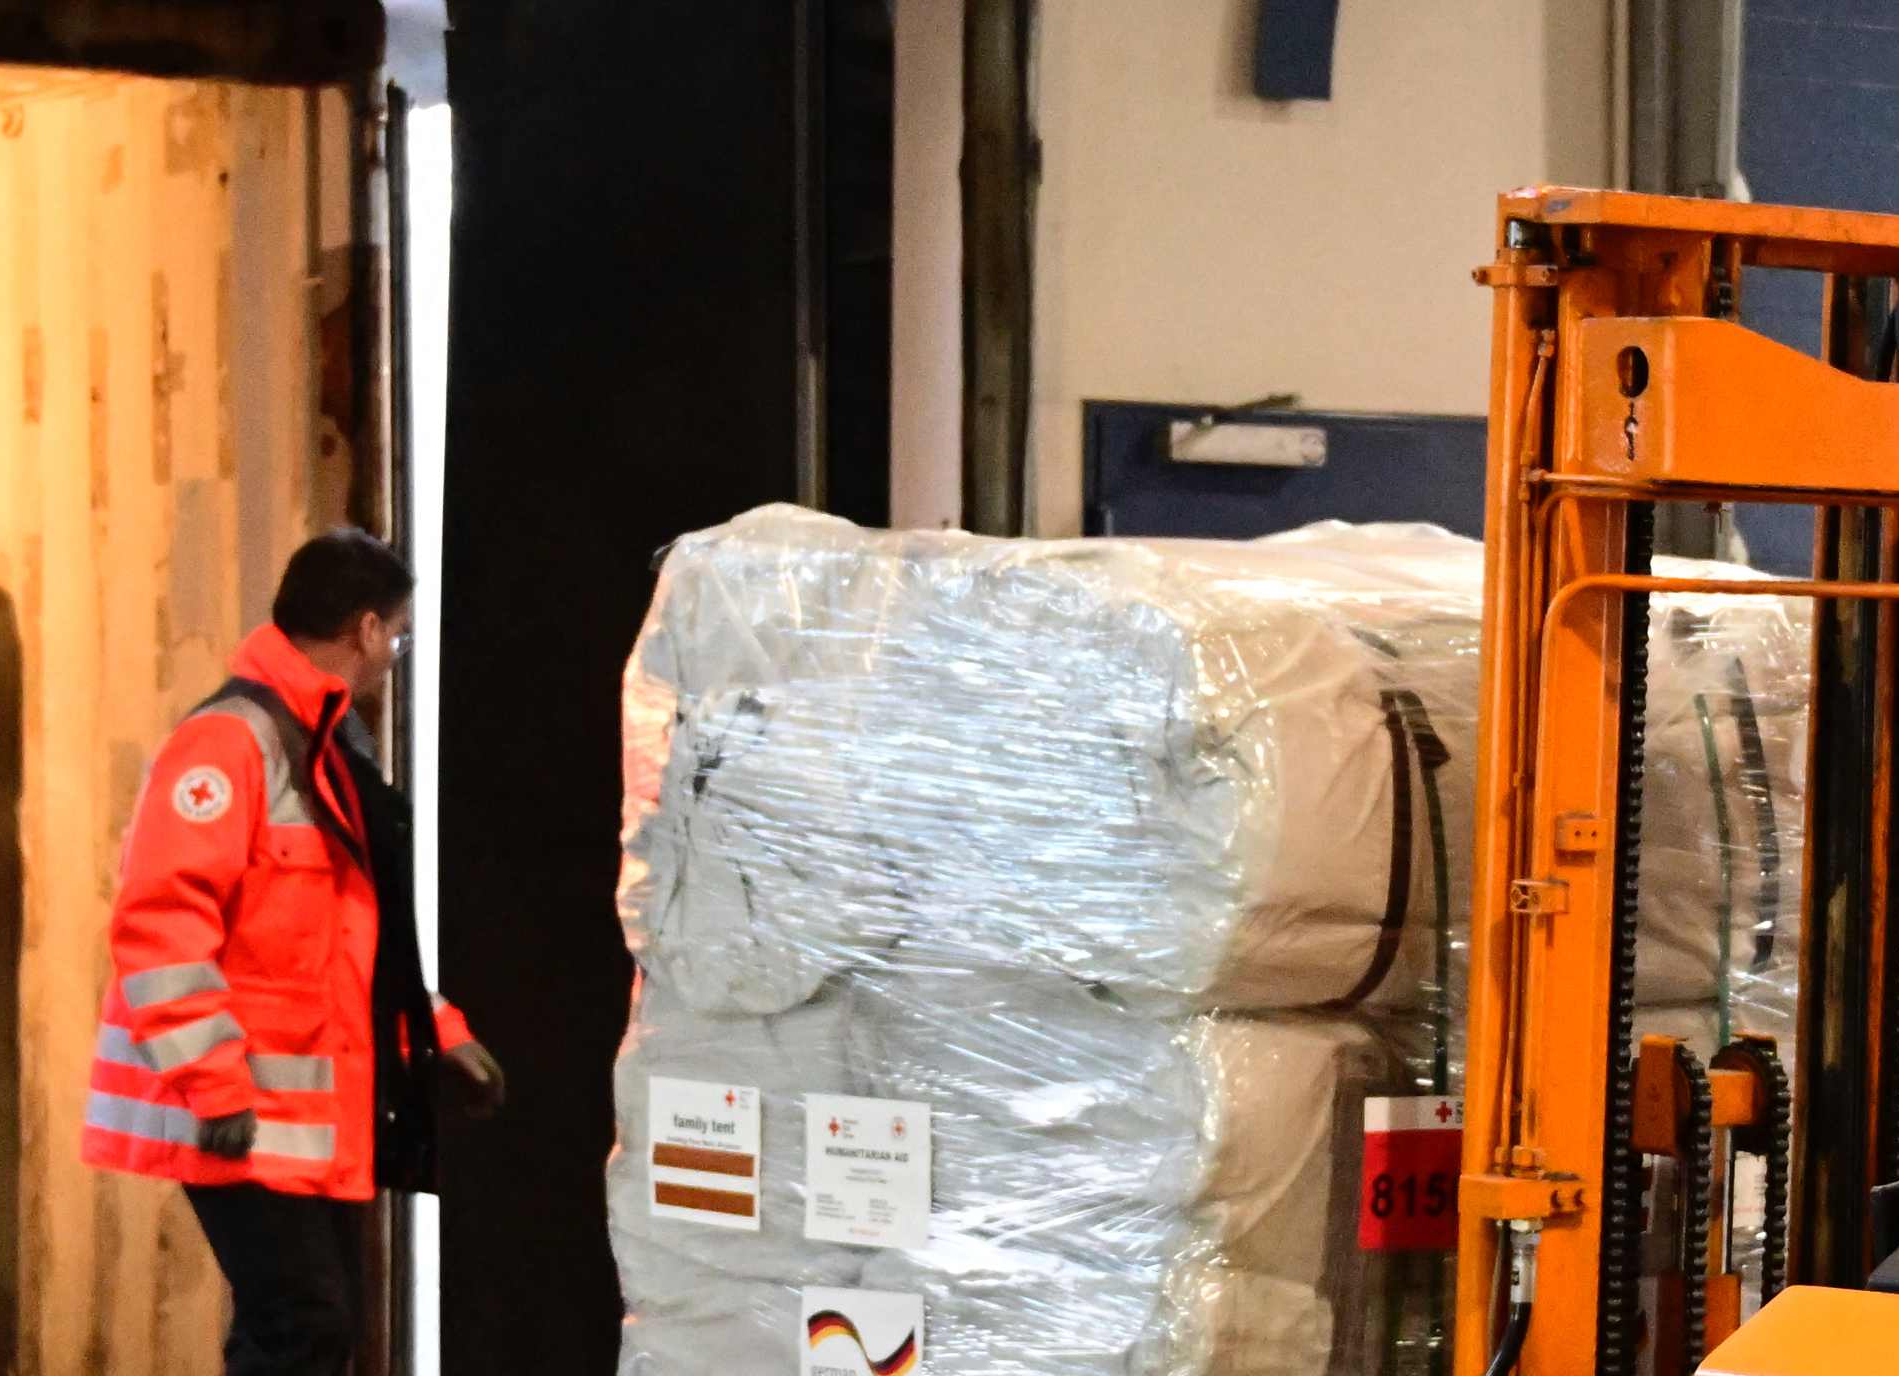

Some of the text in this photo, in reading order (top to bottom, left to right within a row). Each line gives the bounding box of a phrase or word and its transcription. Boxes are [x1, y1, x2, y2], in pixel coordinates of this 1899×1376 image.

[674, 1114, 736, 1135] family tent
[1371, 1172, 1458, 1219] 815
